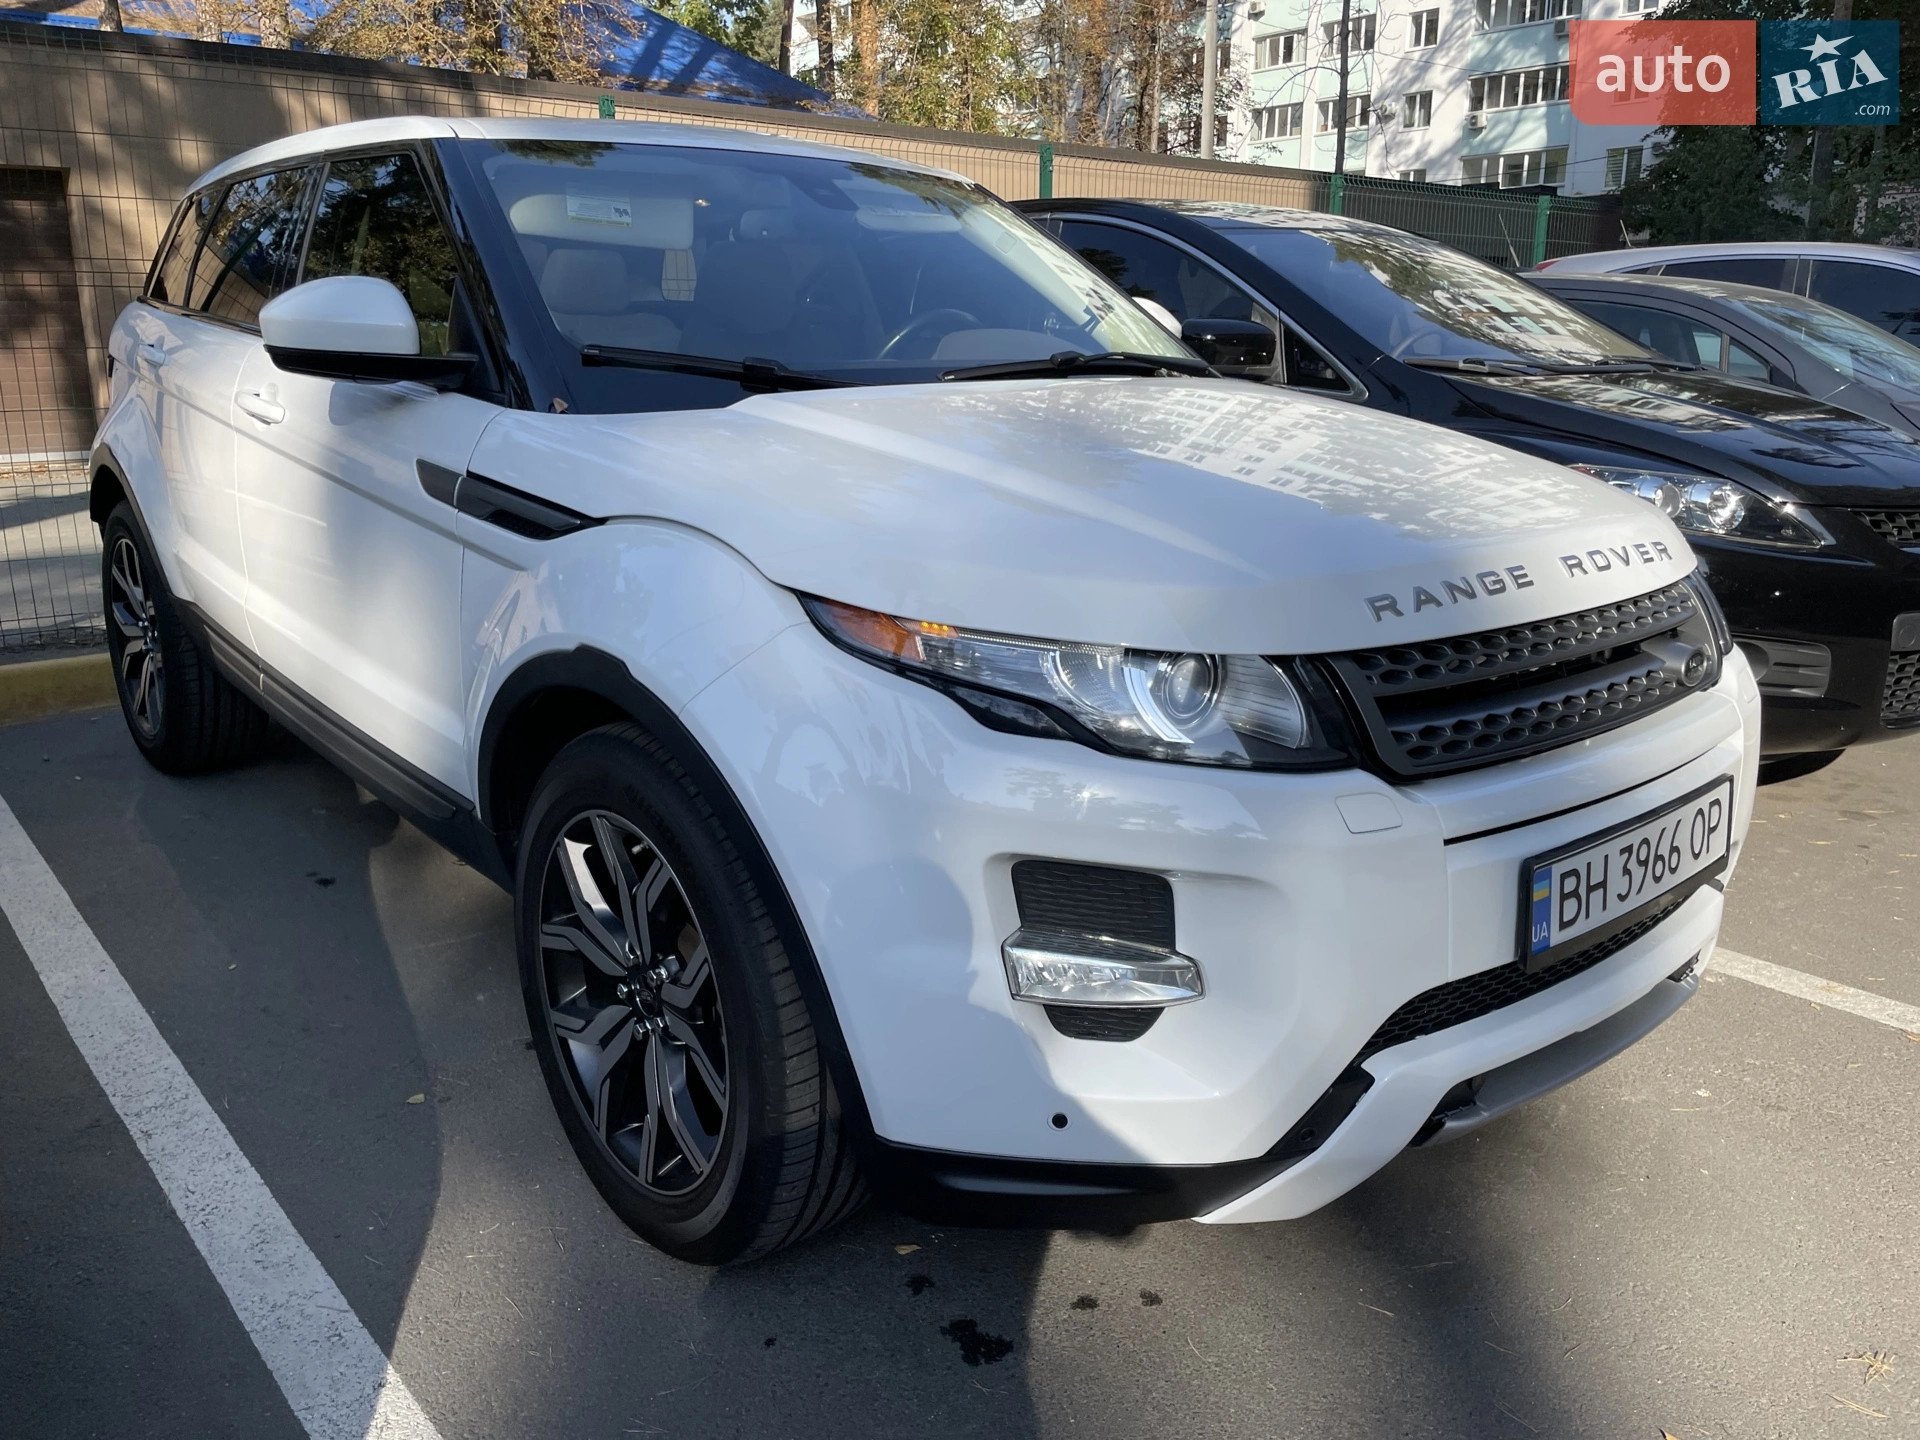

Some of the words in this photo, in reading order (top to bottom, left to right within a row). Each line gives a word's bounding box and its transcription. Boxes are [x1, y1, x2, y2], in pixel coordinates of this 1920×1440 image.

[1363, 564, 1535, 623] RANGE
[1558, 541, 1673, 578] ROVER
[1558, 853, 1609, 932] BH
[1616, 818, 1683, 903] 3966
[1690, 797, 1722, 861] OP
[1531, 920, 1549, 943] UA
